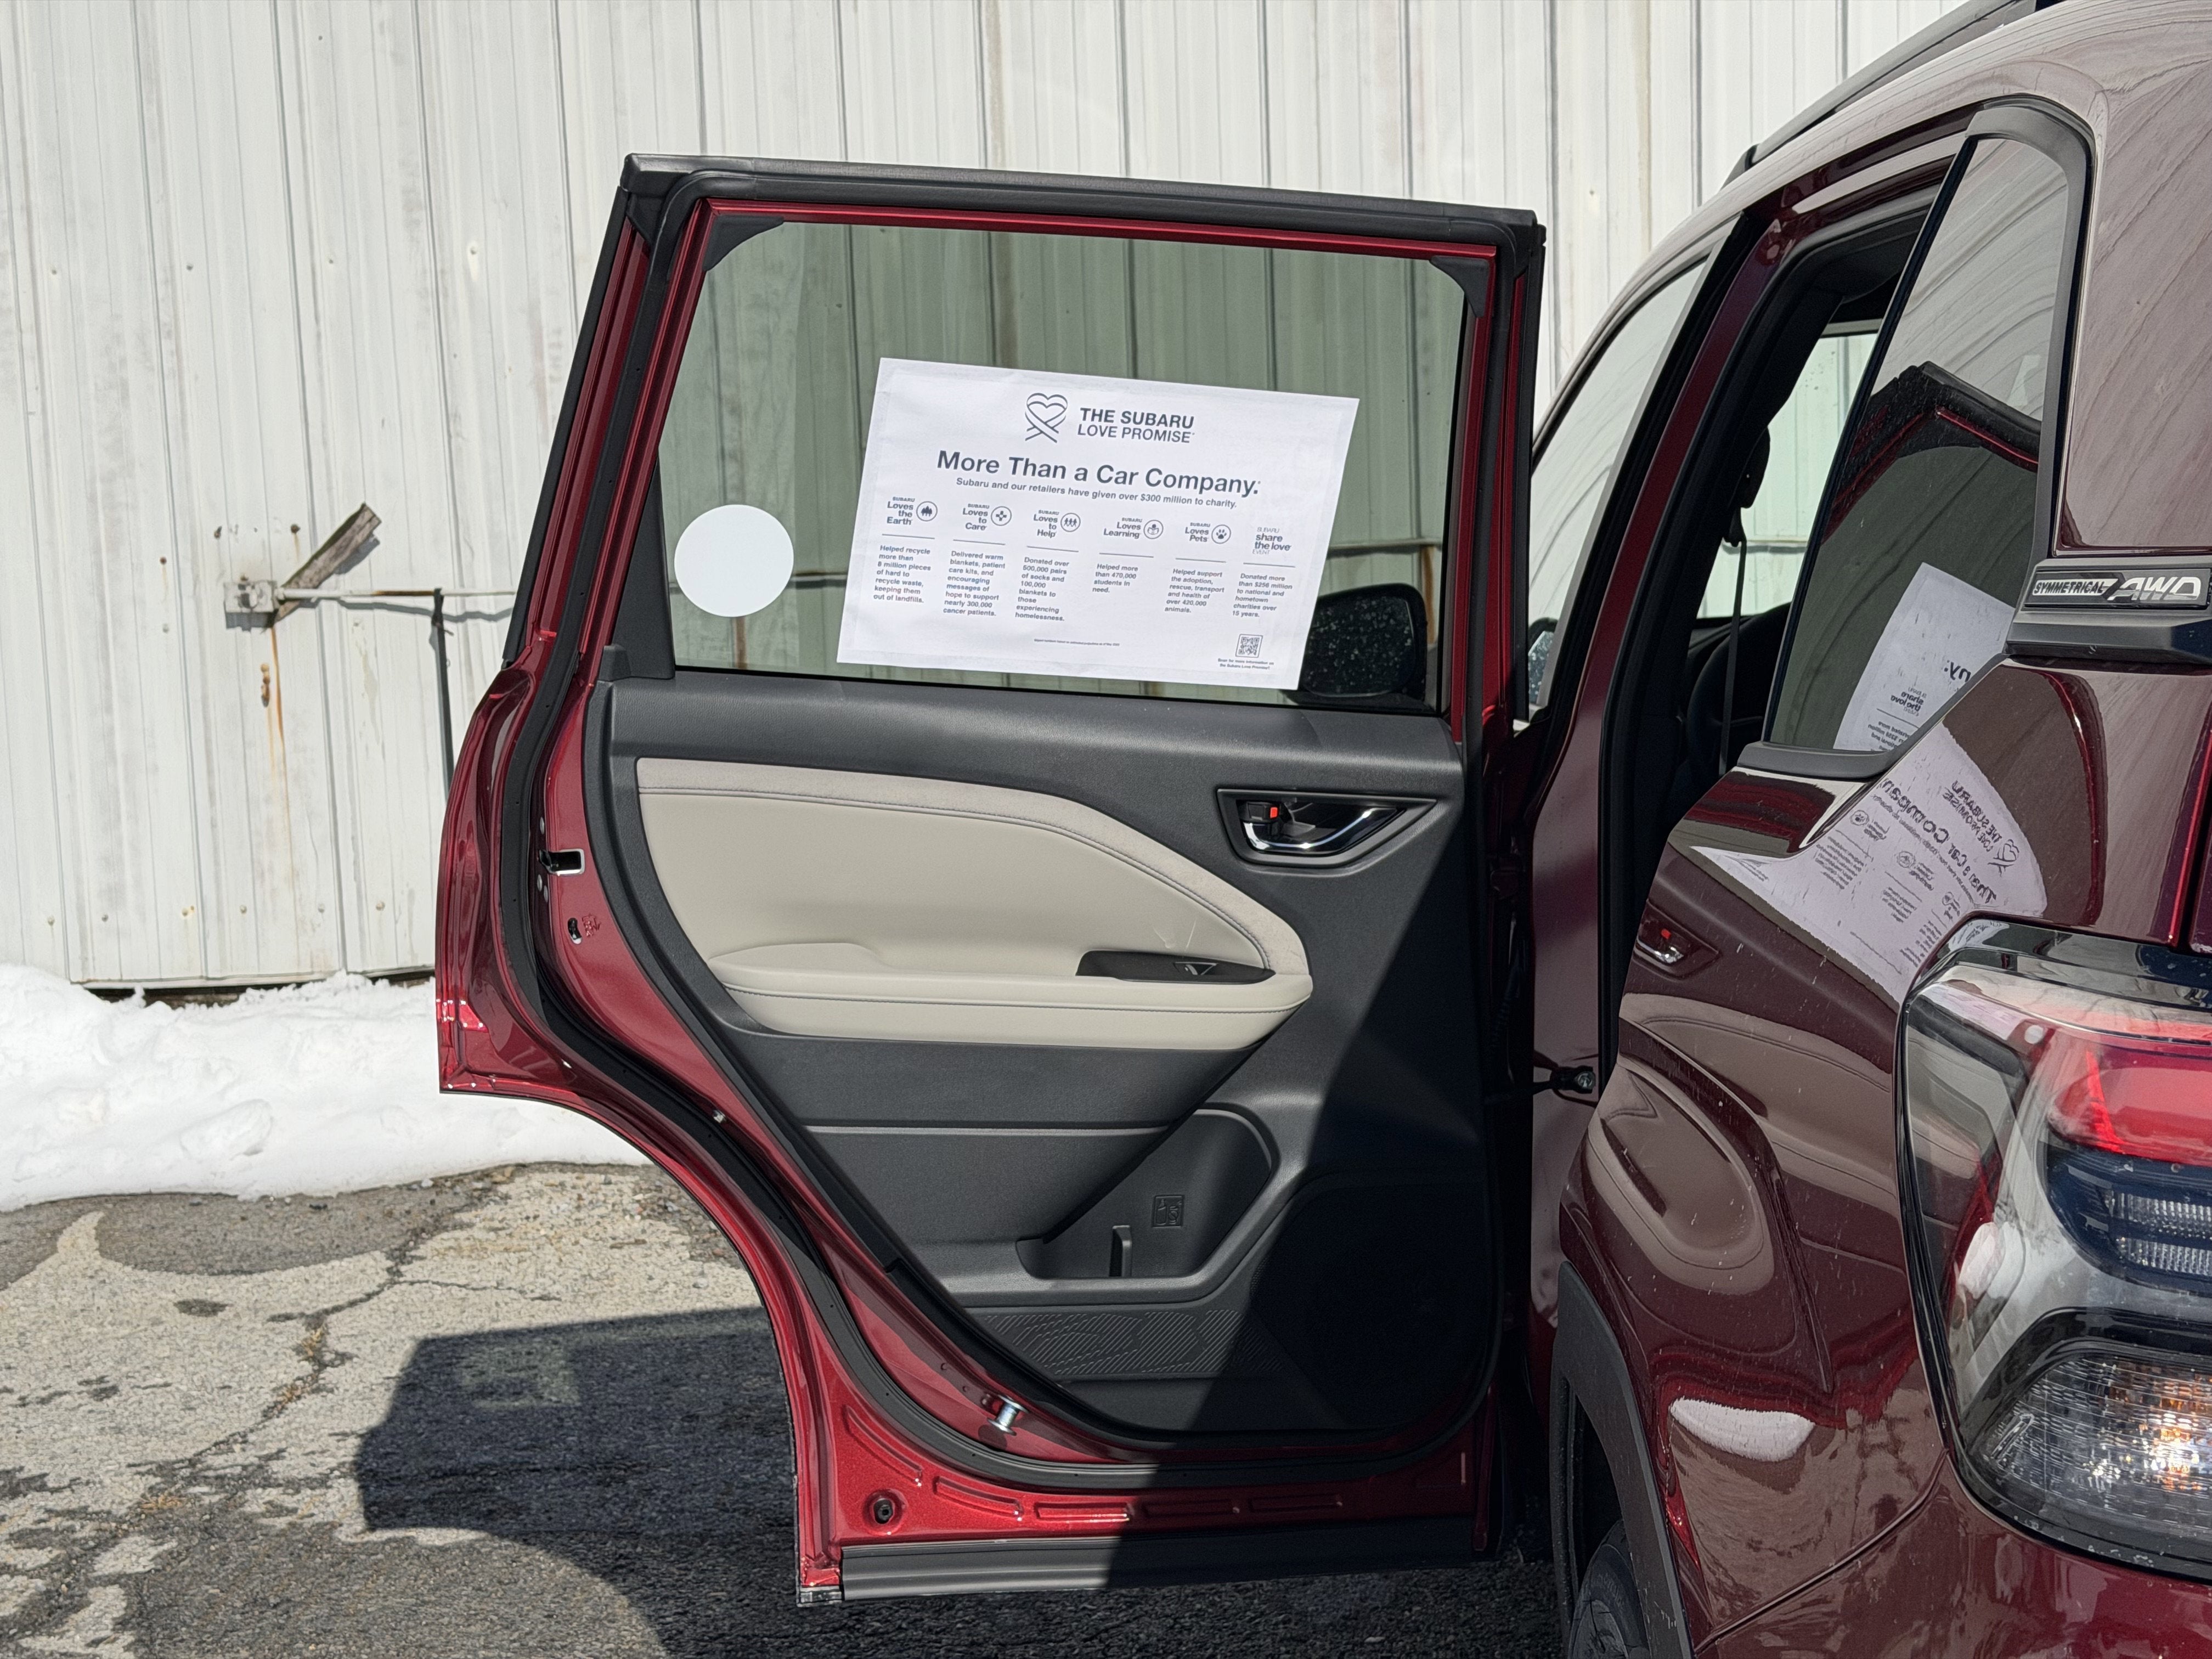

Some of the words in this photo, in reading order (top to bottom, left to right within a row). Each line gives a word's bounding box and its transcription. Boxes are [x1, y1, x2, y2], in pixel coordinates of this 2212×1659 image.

[1080, 408, 1115, 423] THE
[1120, 411, 1194, 429] SUBARU
[1078, 424, 1118, 437] LOVE
[1122, 427, 1191, 443] PROMISE
[938, 450, 1000, 473] More
[1009, 457, 1066, 479] Than
[1074, 467, 1088, 481] a
[1097, 465, 1139, 485] Car
[956, 477, 989, 487] Subaru
[1029, 485, 1065, 494] retailers
[1068, 487, 1090, 496] have
[1092, 490, 1116, 499] given
[1141, 494, 1161, 502] $300
[1206, 499, 1237, 509] charity.
[887, 501, 913, 510] Loves
[963, 507, 988, 517] Loves
[887, 516, 912, 525] Earth
[1034, 514, 1058, 523] Loves
[1116, 522, 1141, 530] Loves
[1037, 529, 1057, 538] Help
[1103, 528, 1140, 539] Learning
[1185, 527, 1209, 535] Loves
[1256, 533, 1283, 542] share
[1255, 541, 1270, 550] the
[1271, 541, 1291, 551] love
[950, 558, 980, 567] blankets,
[1024, 557, 1053, 565] Donated
[947, 576, 990, 585] encouraging
[874, 585, 901, 594] keeping
[2033, 580, 2106, 595] SYMMETRICAL
[2107, 577, 2202, 601] AWD
[1016, 605, 1059, 614] experiencing
[1015, 612, 1064, 621] homelessness.
